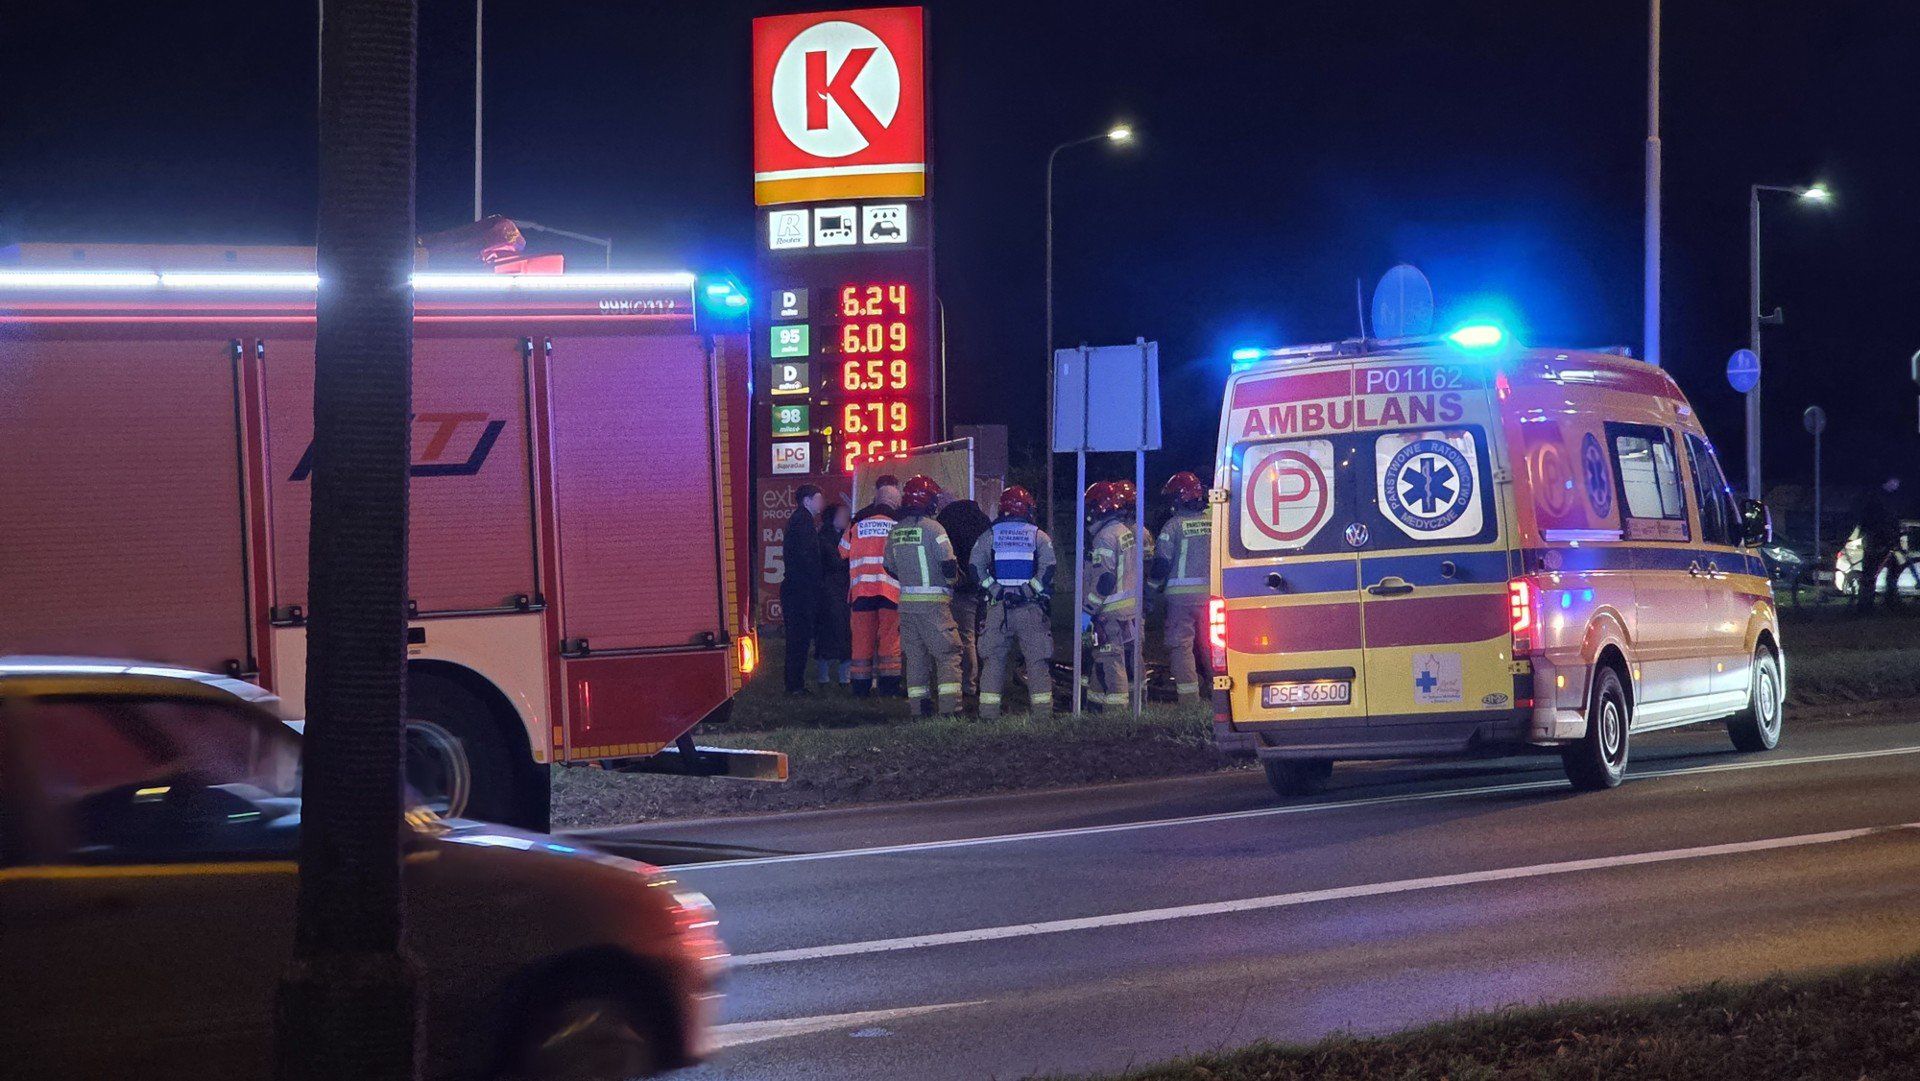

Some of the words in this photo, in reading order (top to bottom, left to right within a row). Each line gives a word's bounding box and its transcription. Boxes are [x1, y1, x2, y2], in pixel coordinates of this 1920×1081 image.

[783, 291, 797, 308] D
[843, 285, 906, 316] 6.24
[780, 329, 800, 344] 95
[843, 322, 907, 353] 6.09
[783, 365, 798, 381] D
[844, 359, 907, 390] 6.59
[1367, 366, 1463, 393] P01162
[780, 408, 801, 424] 98
[844, 401, 907, 433] 6.79
[1242, 392, 1464, 438] AMBULANS
[776, 447, 805, 462] LPG
[1430, 443, 1470, 505] RATOWNICTWO
[763, 485, 797, 508] ext
[1271, 467, 1311, 526] P
[763, 510, 794, 519] PROG
[1400, 510, 1458, 529] MEDYCZNE
[859, 520, 893, 529] RATOWNI
[859, 528, 890, 536] MEDYCZN
[763, 528, 784, 542] RA
[1270, 686, 1299, 703] PSE
[1302, 684, 1347, 701] 56500
